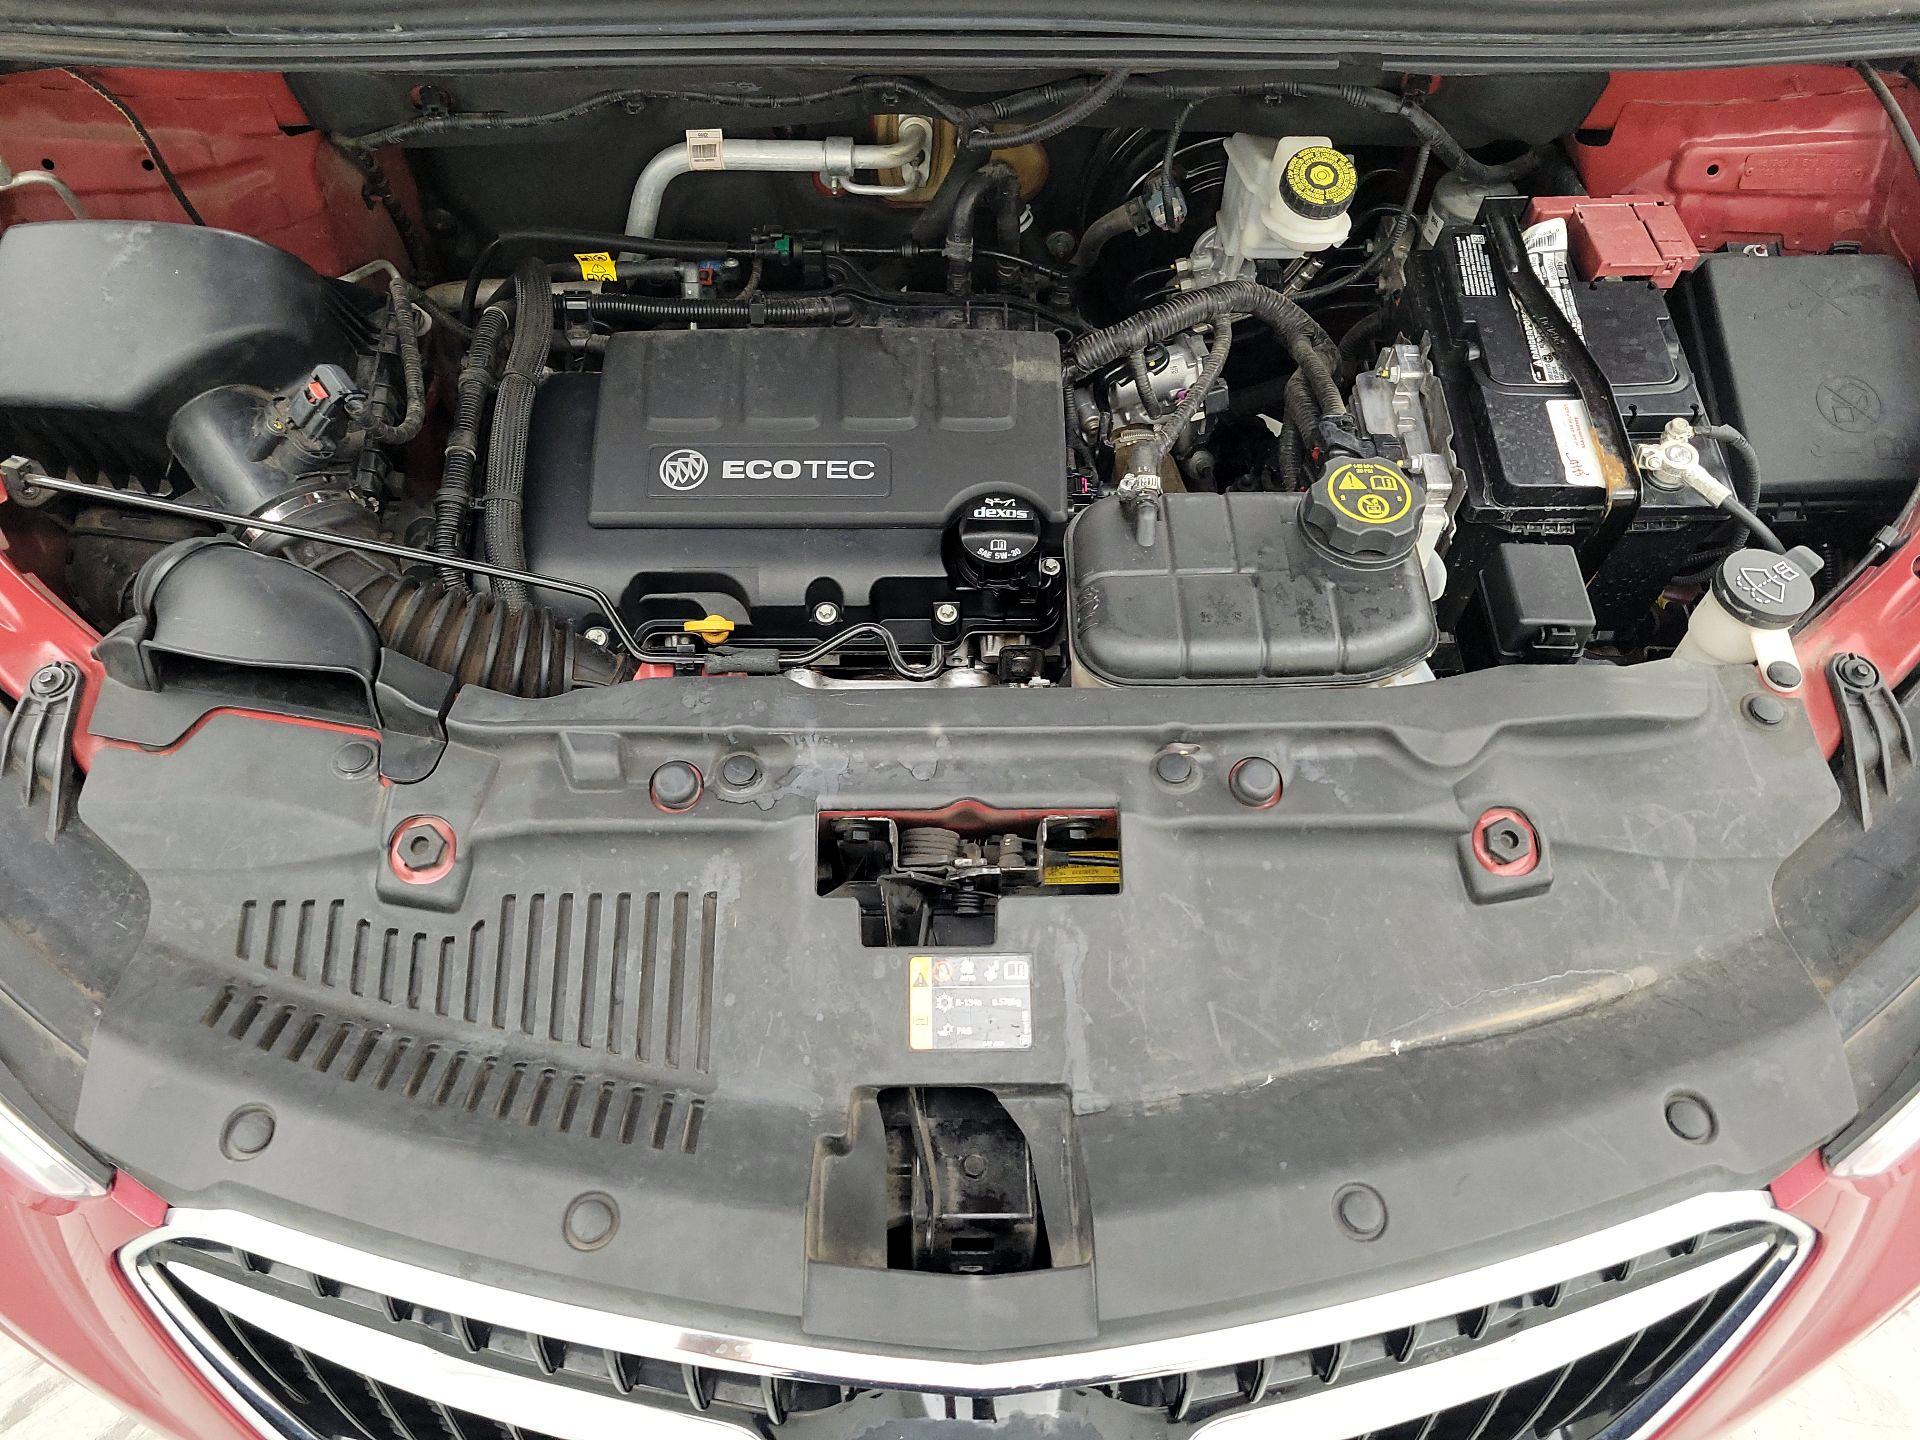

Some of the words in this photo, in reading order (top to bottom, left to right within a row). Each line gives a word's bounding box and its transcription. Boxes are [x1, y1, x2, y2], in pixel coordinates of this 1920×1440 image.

[722, 459, 875, 480] ECOTEC
[974, 507, 1029, 519] dexos
[977, 548, 992, 558] SAE
